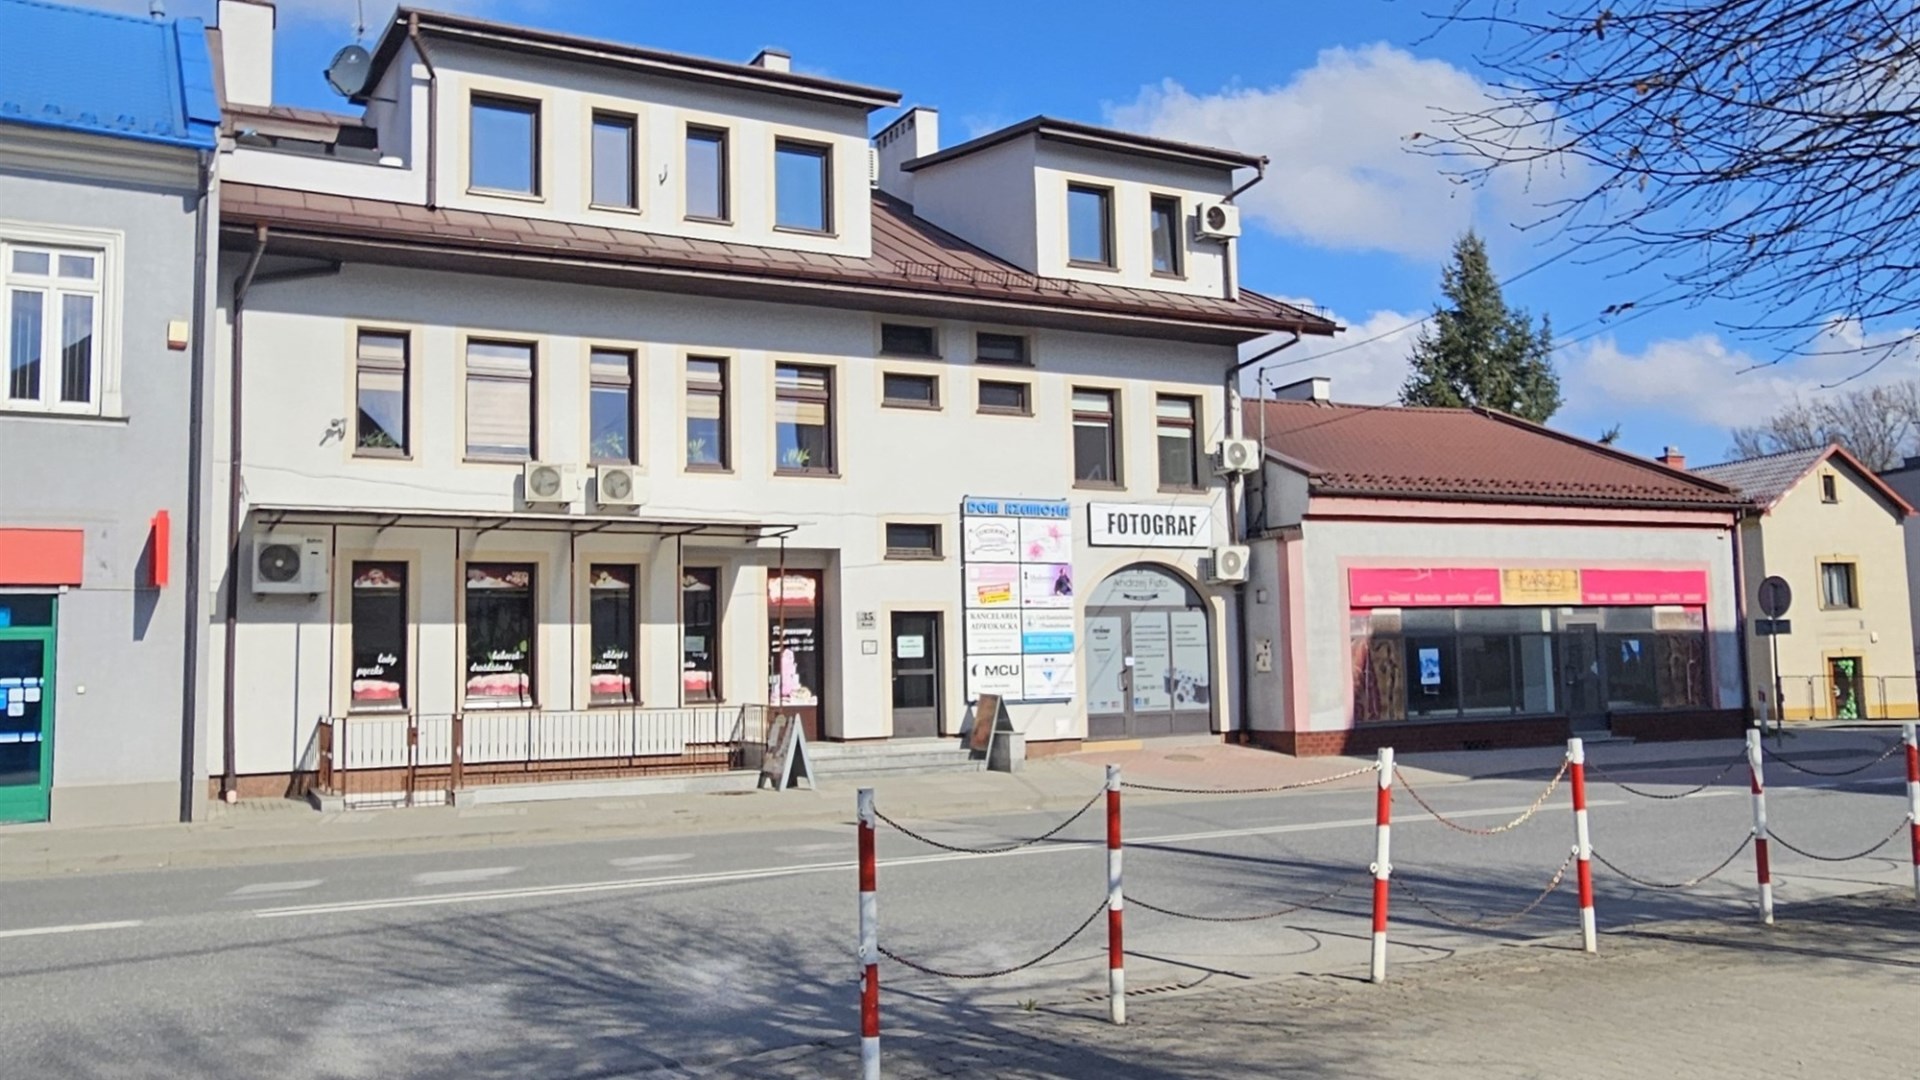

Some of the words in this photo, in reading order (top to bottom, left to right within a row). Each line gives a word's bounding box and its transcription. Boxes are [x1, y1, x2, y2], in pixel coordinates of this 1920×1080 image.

[967, 501, 998, 514] DOM
[1107, 512, 1198, 536] FOTOGRAF
[1113, 578, 1147, 590] Andrzej
[861, 611, 874, 621] 35
[377, 653, 398, 666] lody
[984, 665, 1020, 676] MCU
